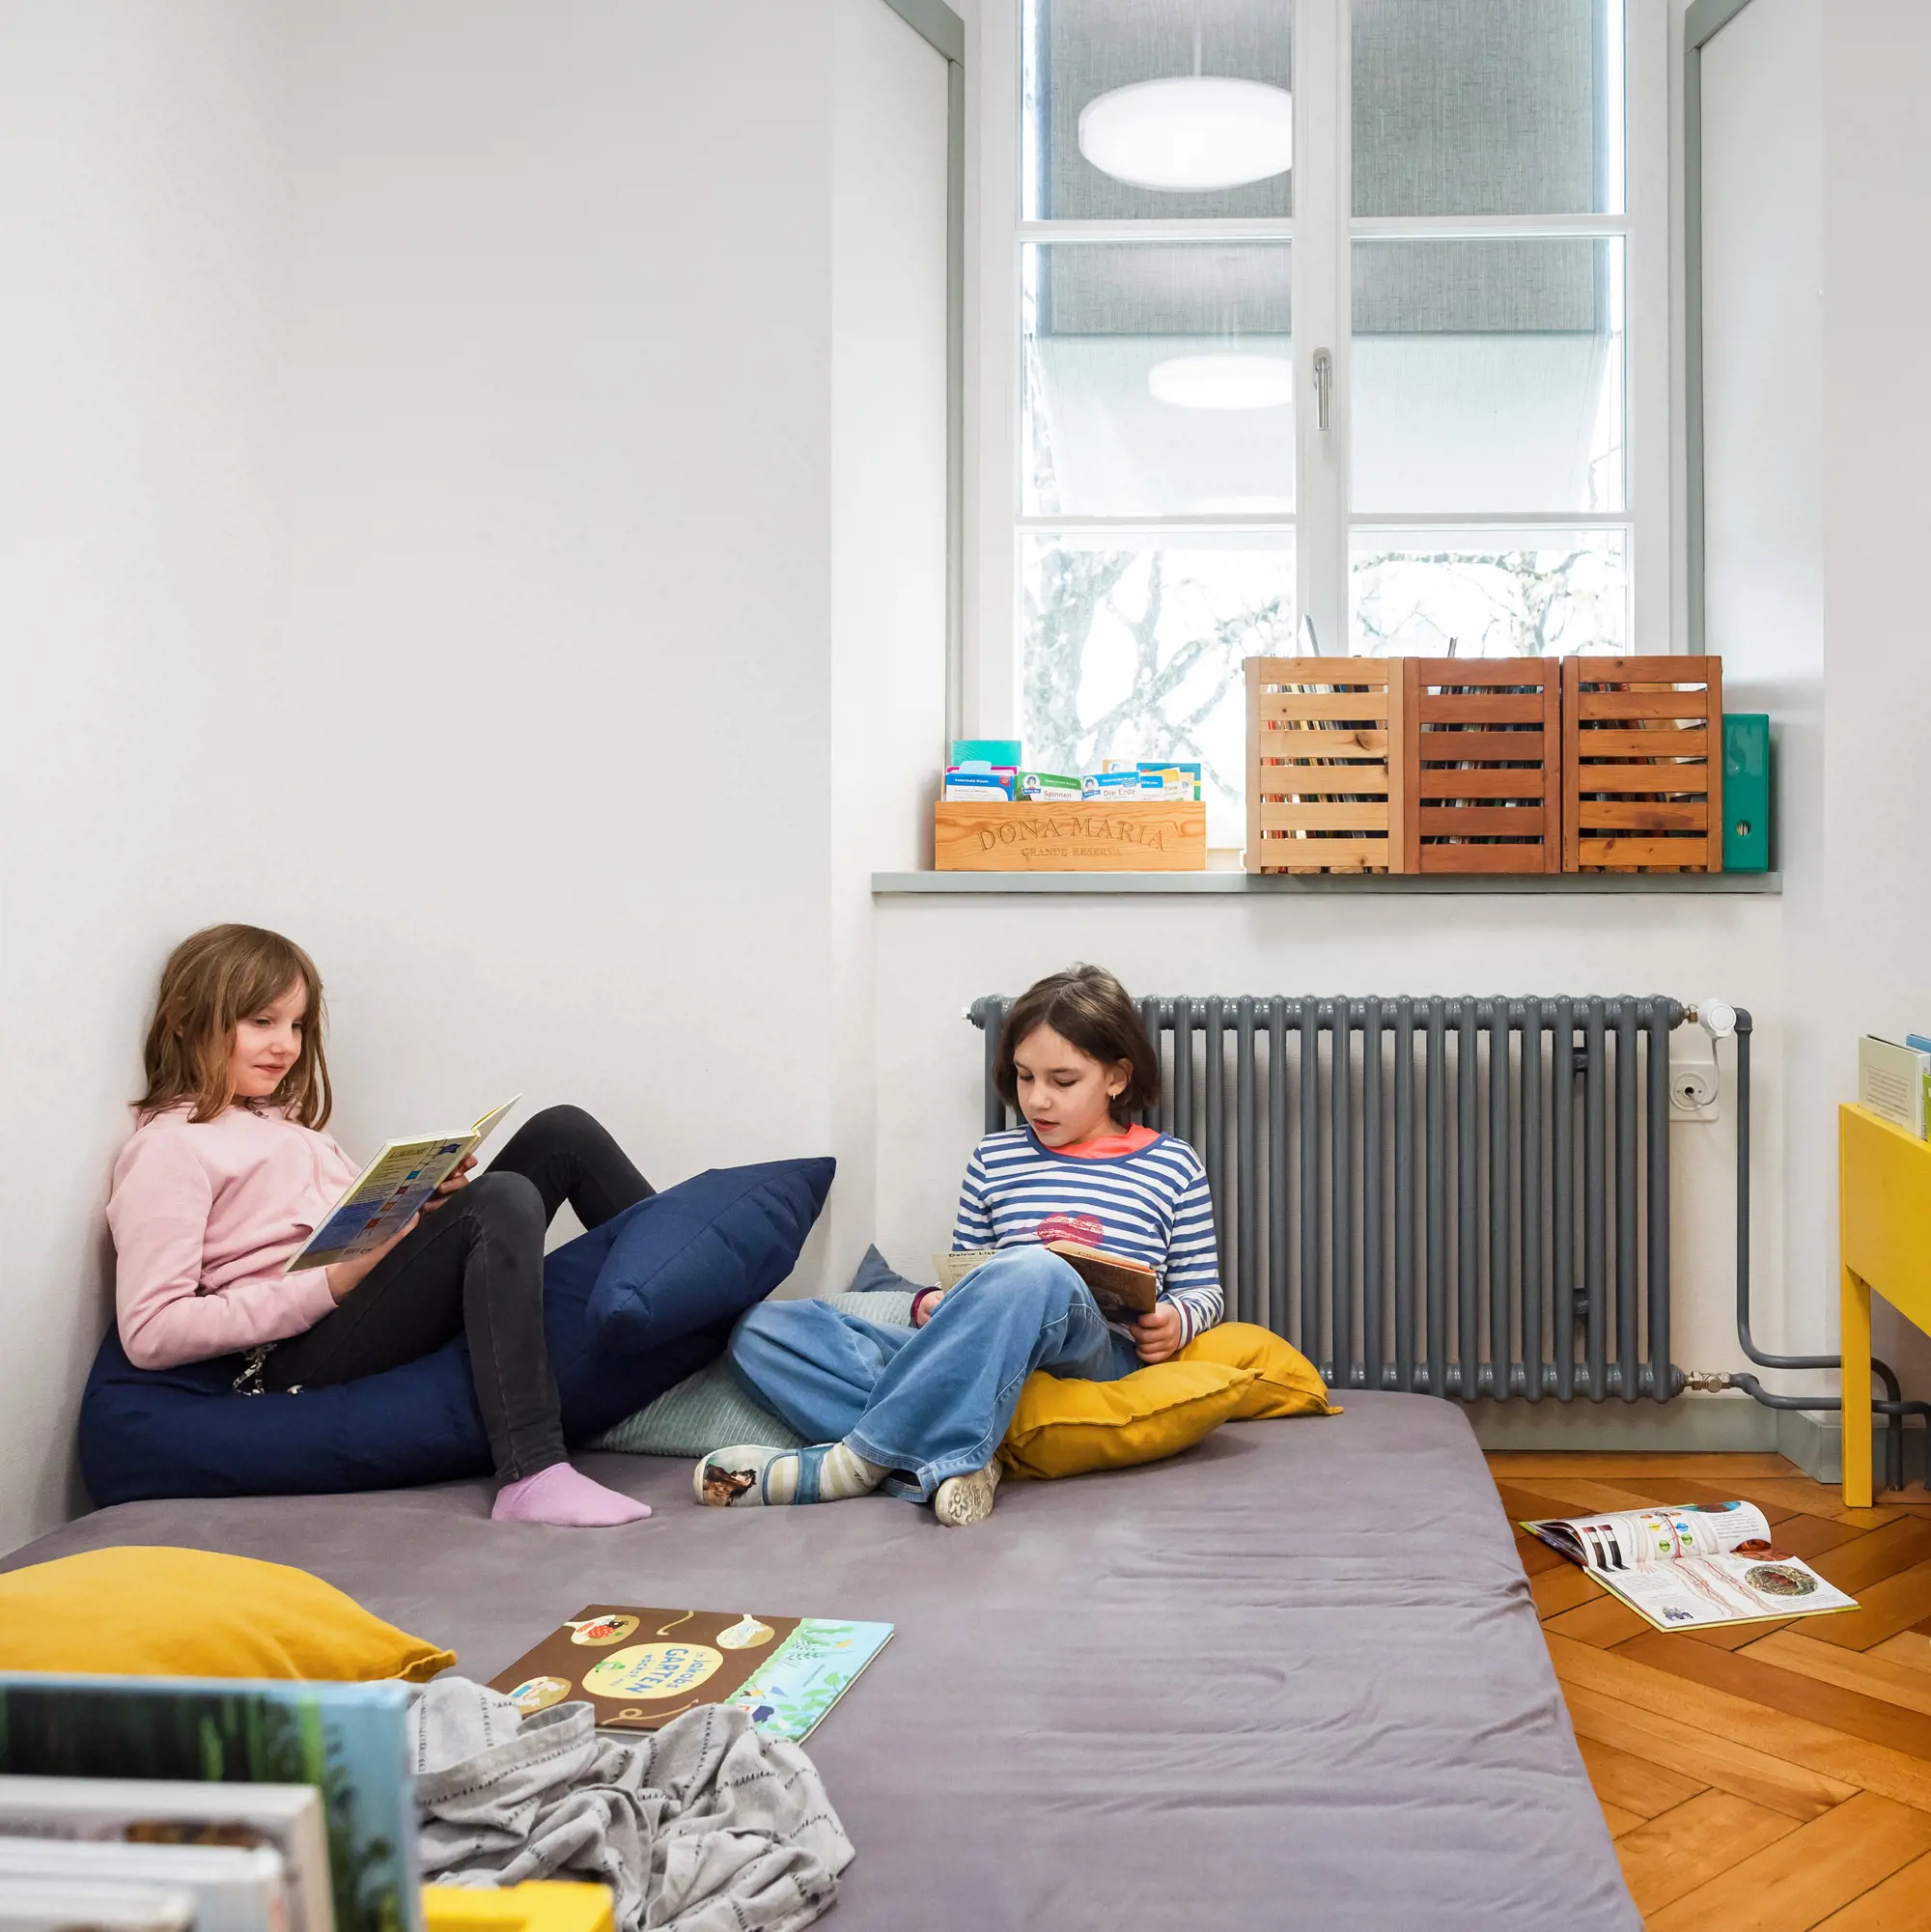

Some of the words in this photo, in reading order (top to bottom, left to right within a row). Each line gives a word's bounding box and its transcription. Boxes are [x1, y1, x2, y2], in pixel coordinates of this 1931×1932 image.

[977, 818, 1062, 852] DONA
[1070, 817, 1165, 853] MARIA
[1073, 847, 1122, 857] RESERVA
[625, 1648, 688, 1694] GARTEN
[666, 1660, 712, 1689] Jakobs
